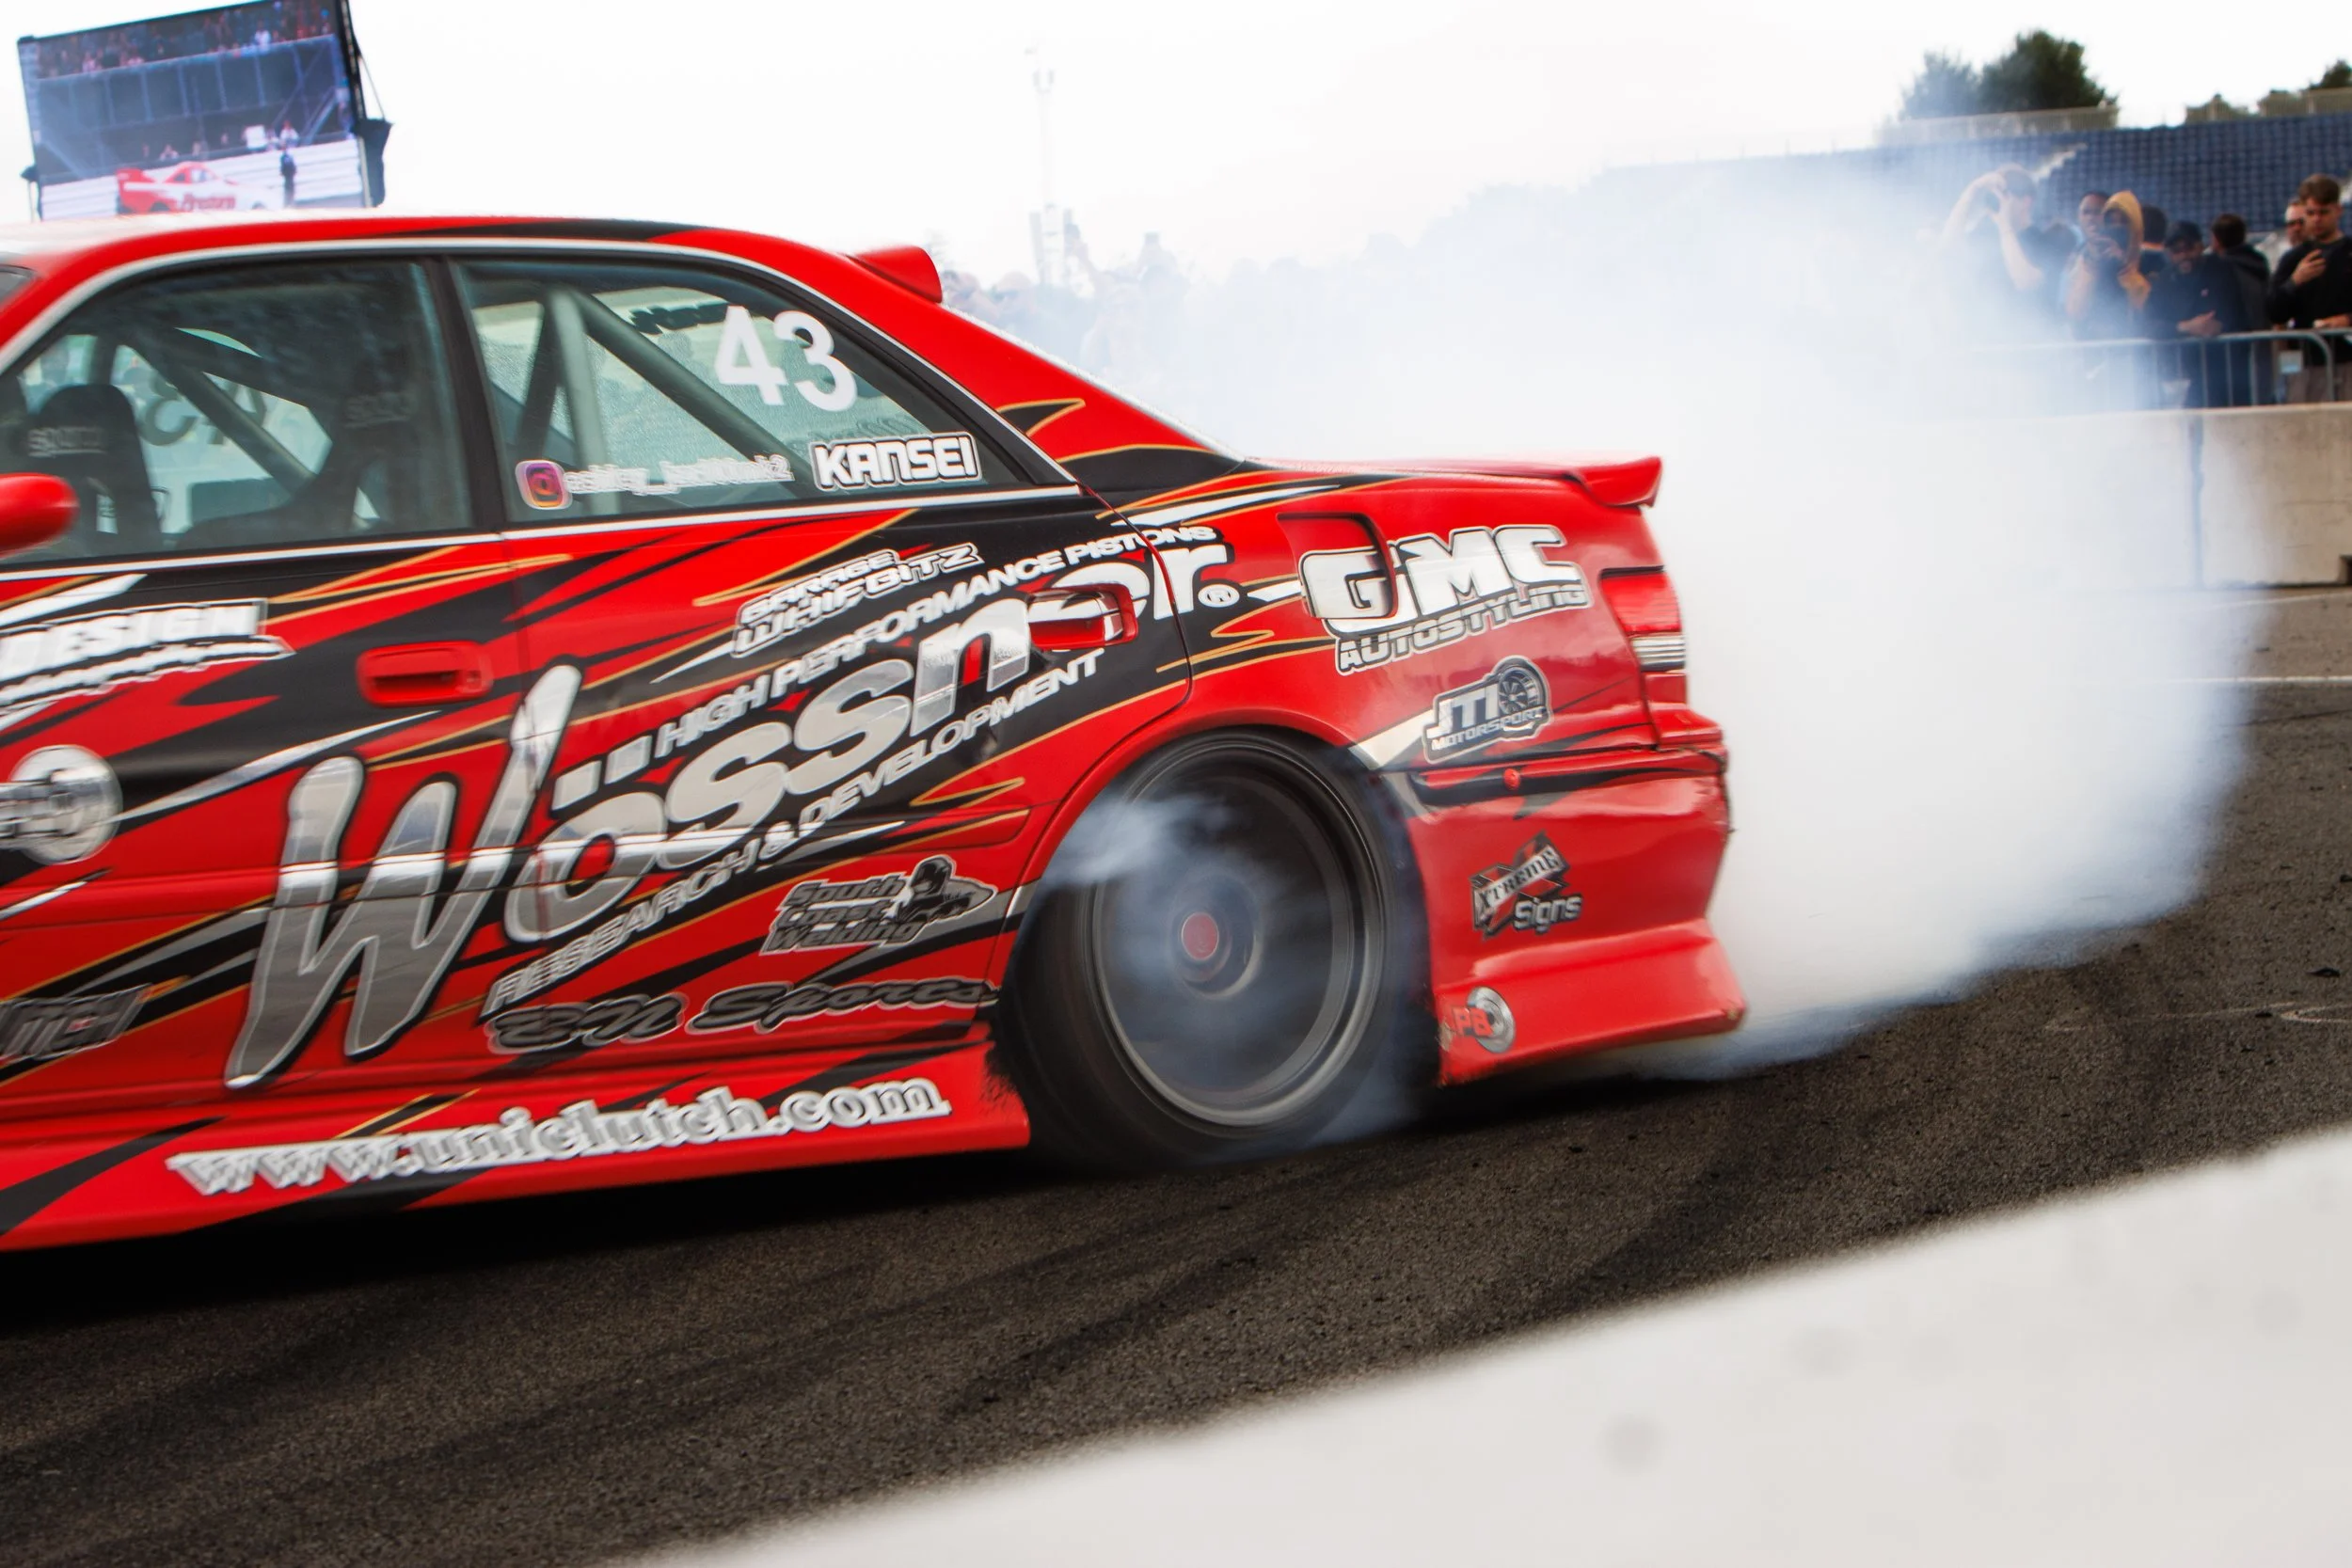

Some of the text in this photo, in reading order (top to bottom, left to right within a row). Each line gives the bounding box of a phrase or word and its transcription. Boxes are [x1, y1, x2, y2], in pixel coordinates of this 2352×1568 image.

[714, 305, 858, 412] 43
[811, 435, 980, 488] KANSEI
[739, 551, 896, 625] GARAGE
[1302, 526, 1584, 633] GMC
[654, 525, 1218, 758] HIGH PERFORMANCE PISTONS
[1339, 583, 1589, 672] AUTOSTYLING
[1431, 705, 1546, 751] MOTORSPORT
[479, 646, 1105, 1022] RESEARCH & DEVELOPMENT
[775, 899, 894, 928] Coast
[783, 874, 907, 908] South
[1513, 895, 1583, 934] Signs
[766, 917, 929, 951] Welding
[690, 979, 1000, 1031] Sports
[167, 1078, 952, 1196] www.uniclutch.com
